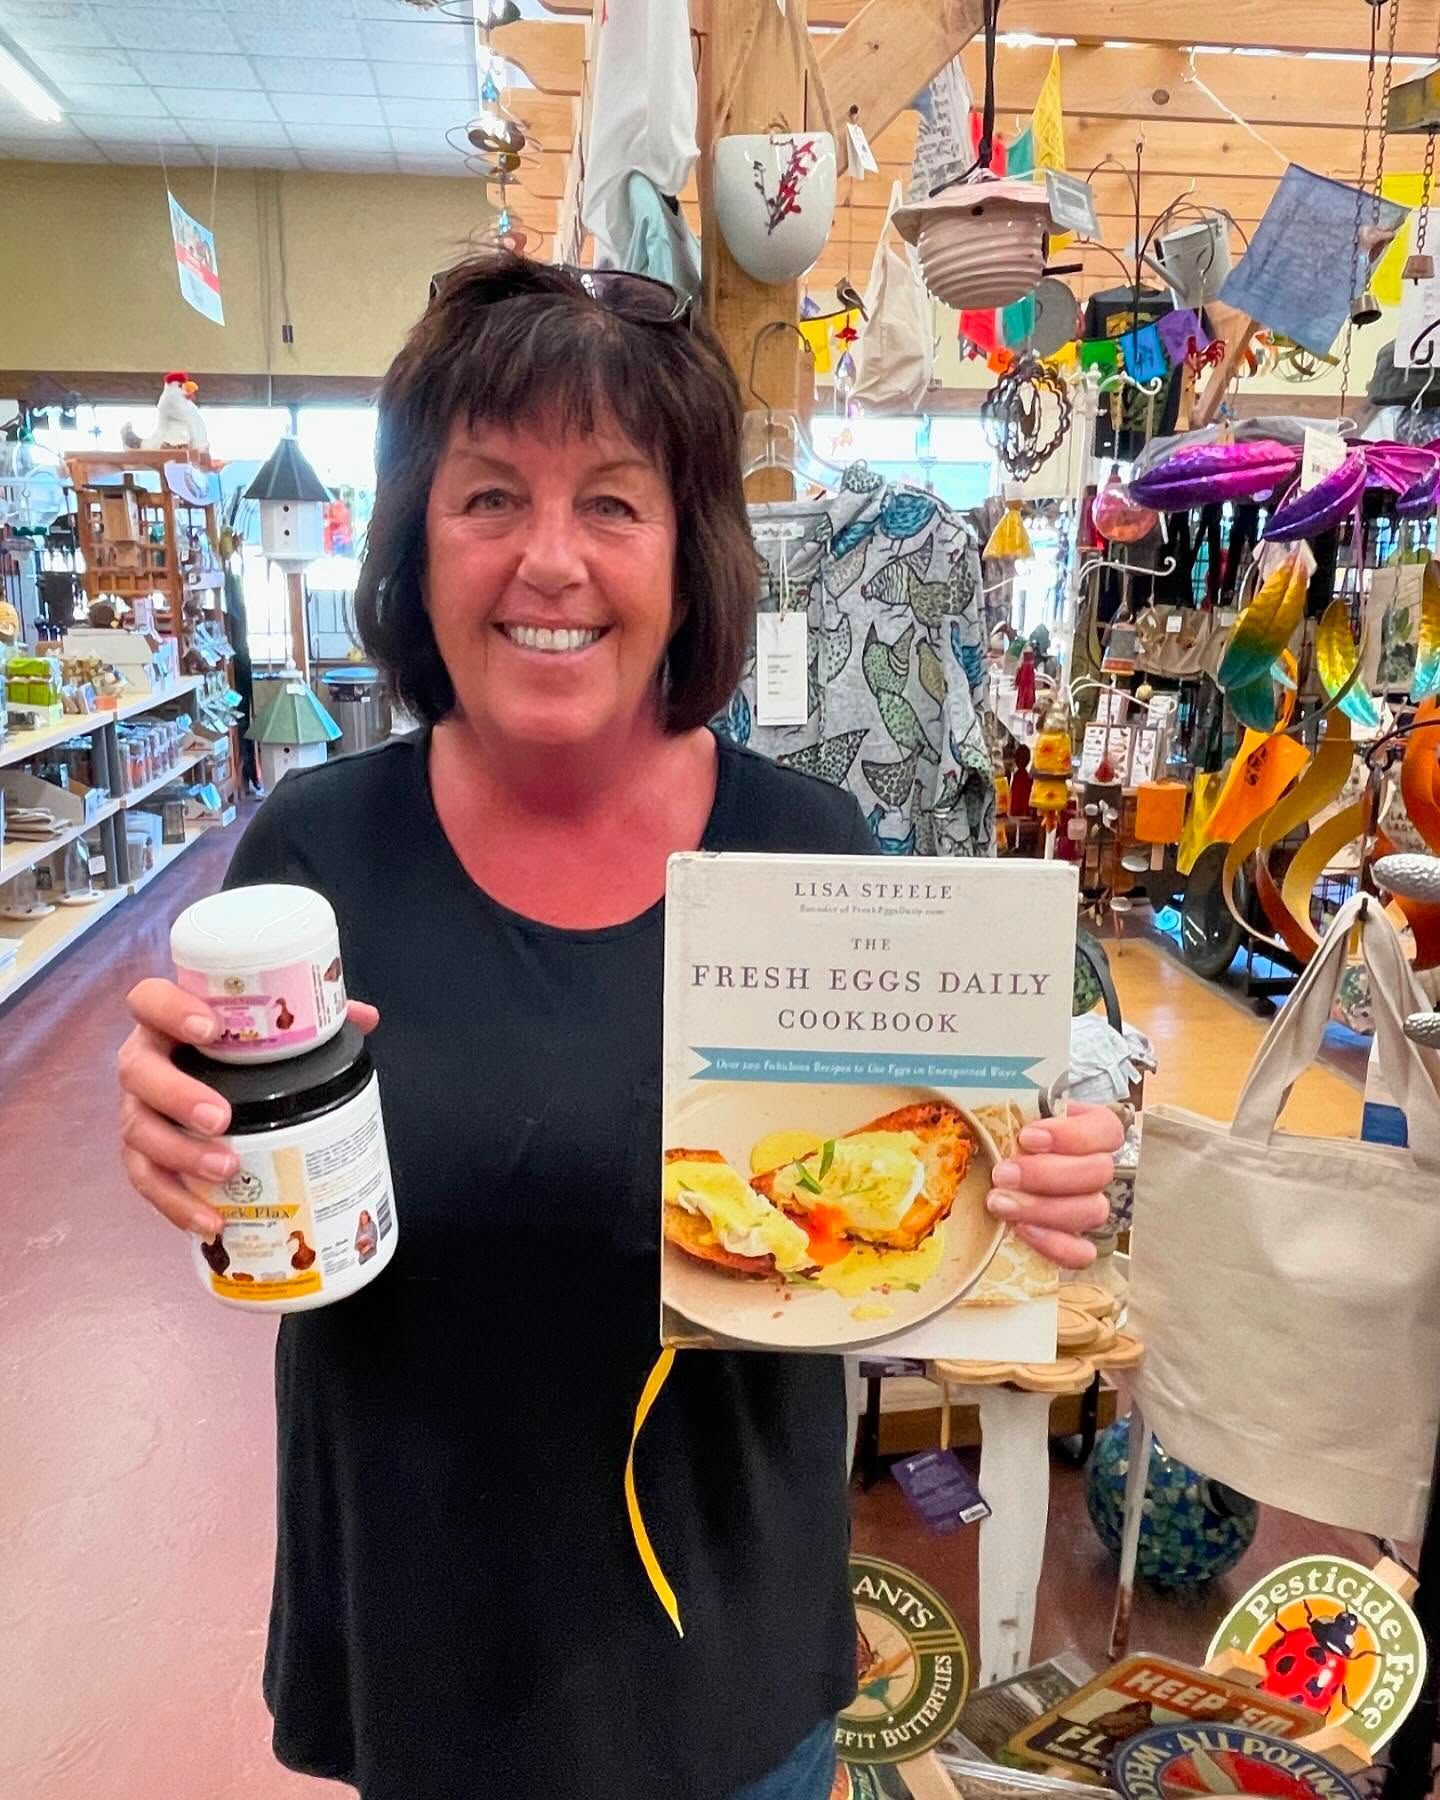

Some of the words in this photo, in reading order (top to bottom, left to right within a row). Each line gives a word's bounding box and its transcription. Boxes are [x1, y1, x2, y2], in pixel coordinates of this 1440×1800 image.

[794, 882, 849, 898] LISA
[861, 883, 953, 899] STEELE
[850, 937, 892, 951] THE
[691, 964, 810, 990] FRESH
[828, 968, 921, 992] EGGS
[937, 971, 1051, 996] DAILY
[777, 1008, 960, 1034] COOKBOOK
[813, 1060, 851, 1075] Recipes
[888, 1063, 911, 1077] Eggs
[255, 1204, 290, 1219] Flax
[852, 1575, 935, 1629] ANTS
[1245, 1566, 1402, 1640] Pesticide
[1362, 1652, 1414, 1730] Free
[1123, 1668, 1230, 1711] KEEP
[834, 1727, 876, 1749] EFIT
[1177, 1731, 1231, 1753] ALL
